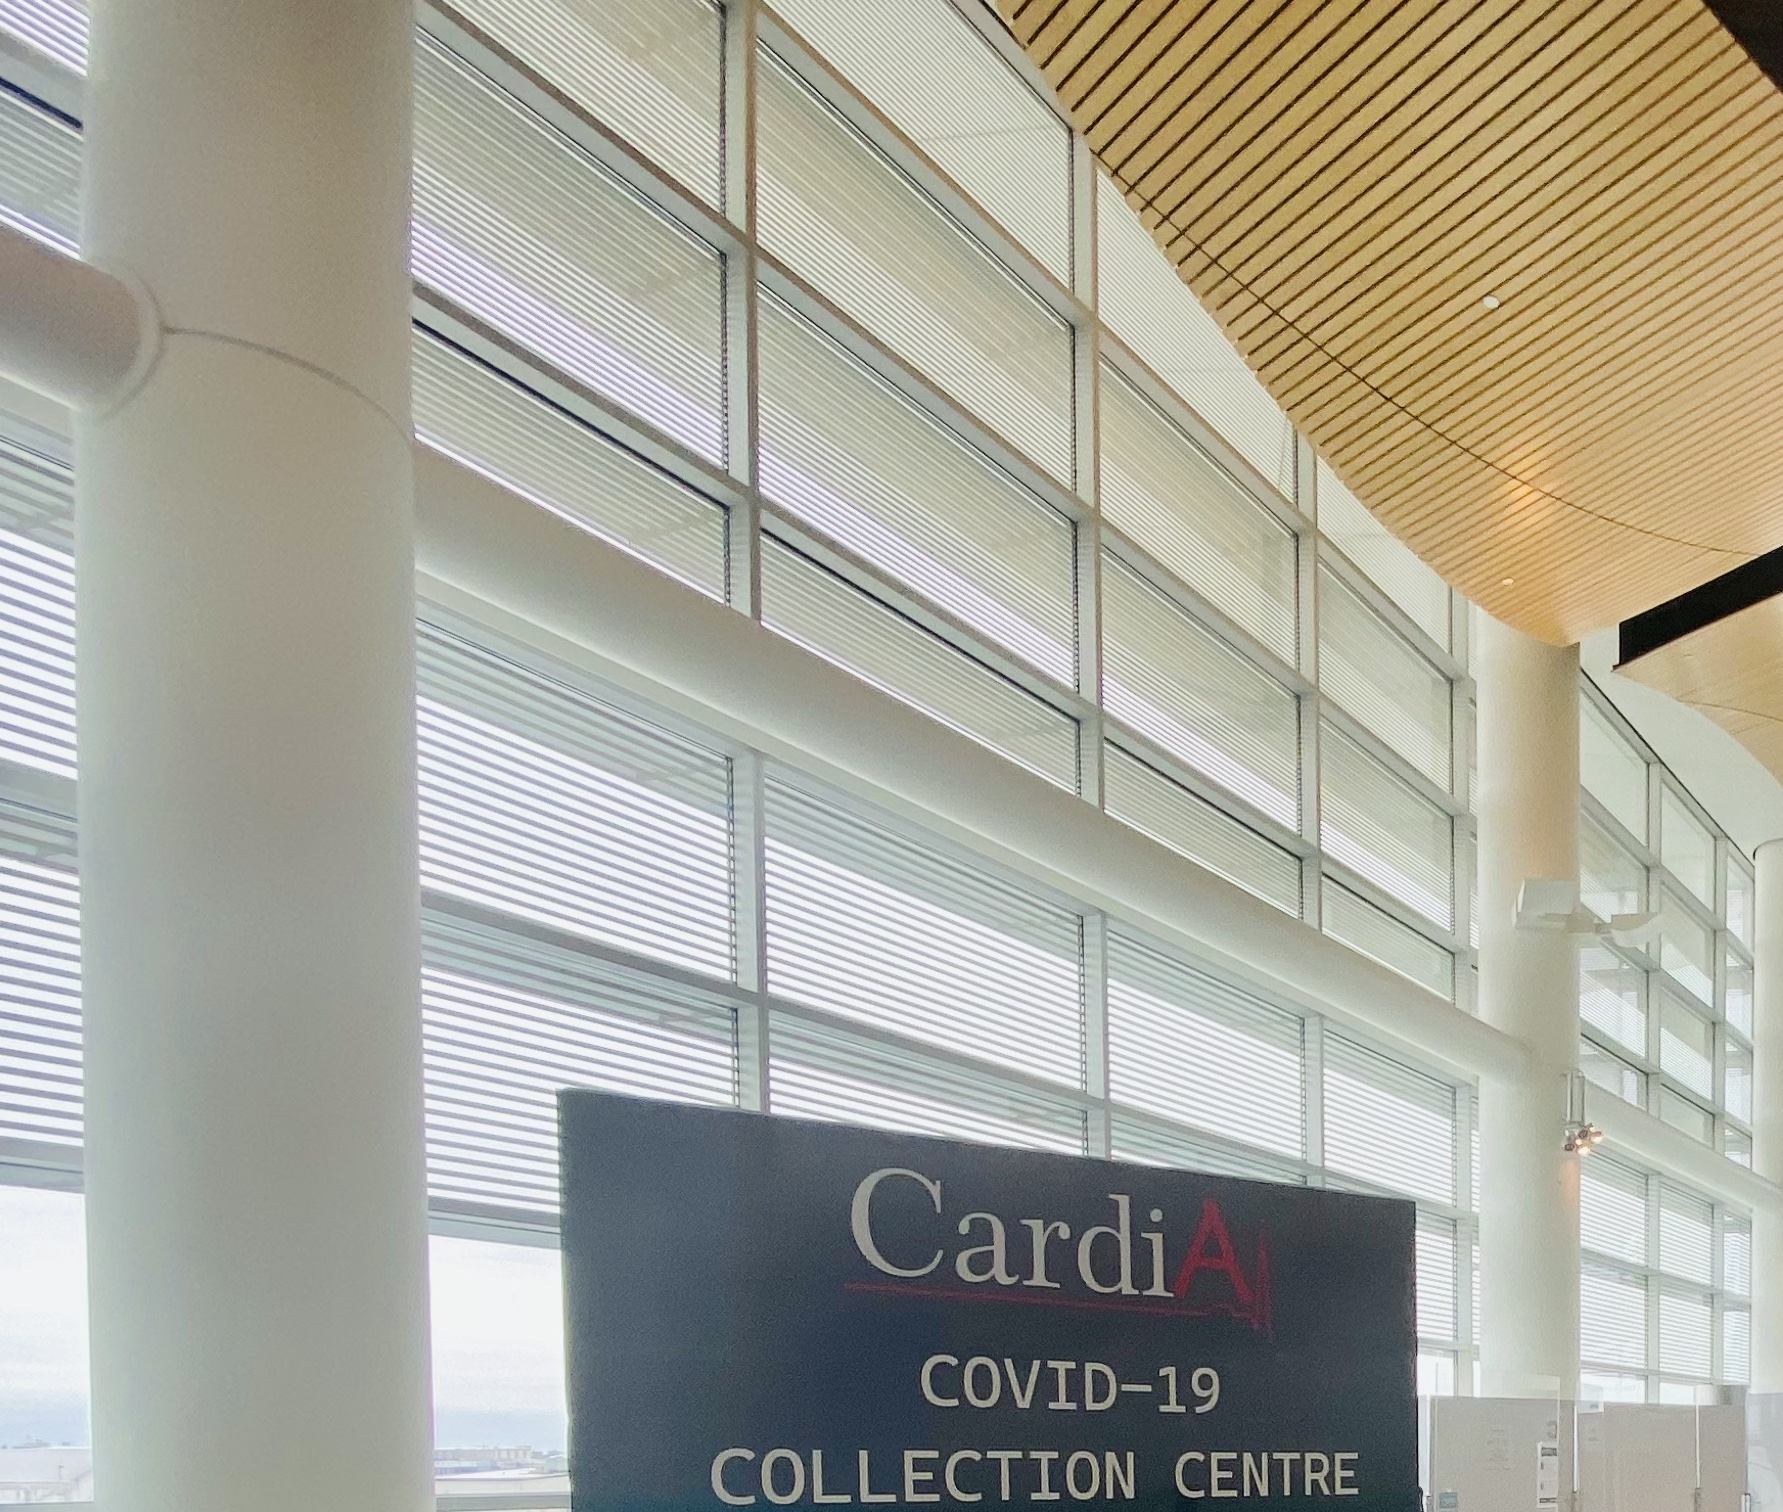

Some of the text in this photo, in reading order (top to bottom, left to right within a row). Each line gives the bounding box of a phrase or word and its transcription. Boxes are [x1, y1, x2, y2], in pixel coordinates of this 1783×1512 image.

[919, 1354, 1222, 1413] COVID-19
[711, 1447, 1360, 1506] COLLECTION CENTRE
